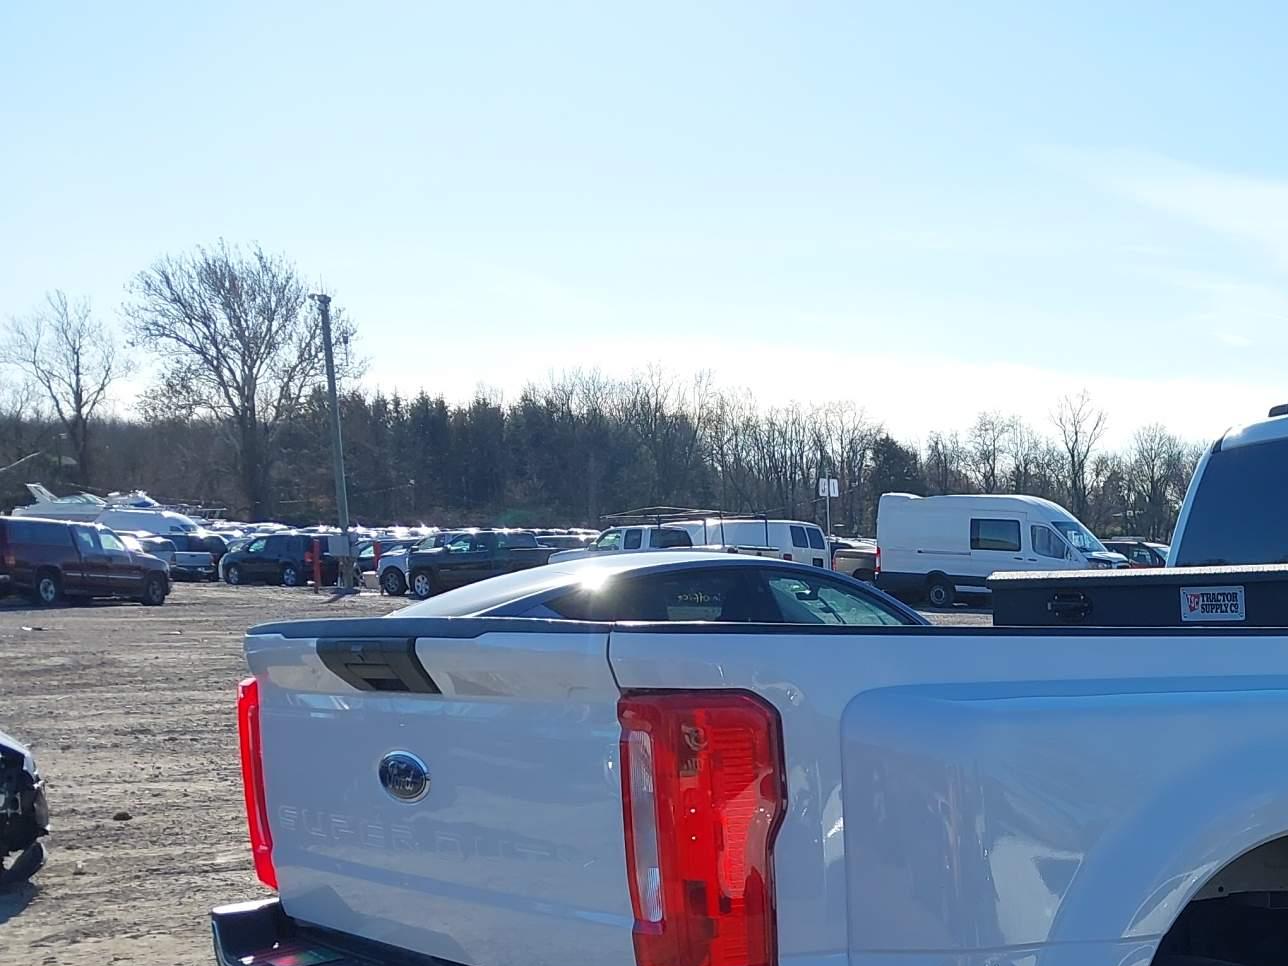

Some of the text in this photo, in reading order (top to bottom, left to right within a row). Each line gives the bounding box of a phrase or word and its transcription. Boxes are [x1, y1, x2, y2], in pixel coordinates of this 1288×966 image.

[1200, 592, 1239, 603] TRACTOR
[1200, 603, 1229, 614] SUPPLY
[278, 804, 418, 854] SUPER
